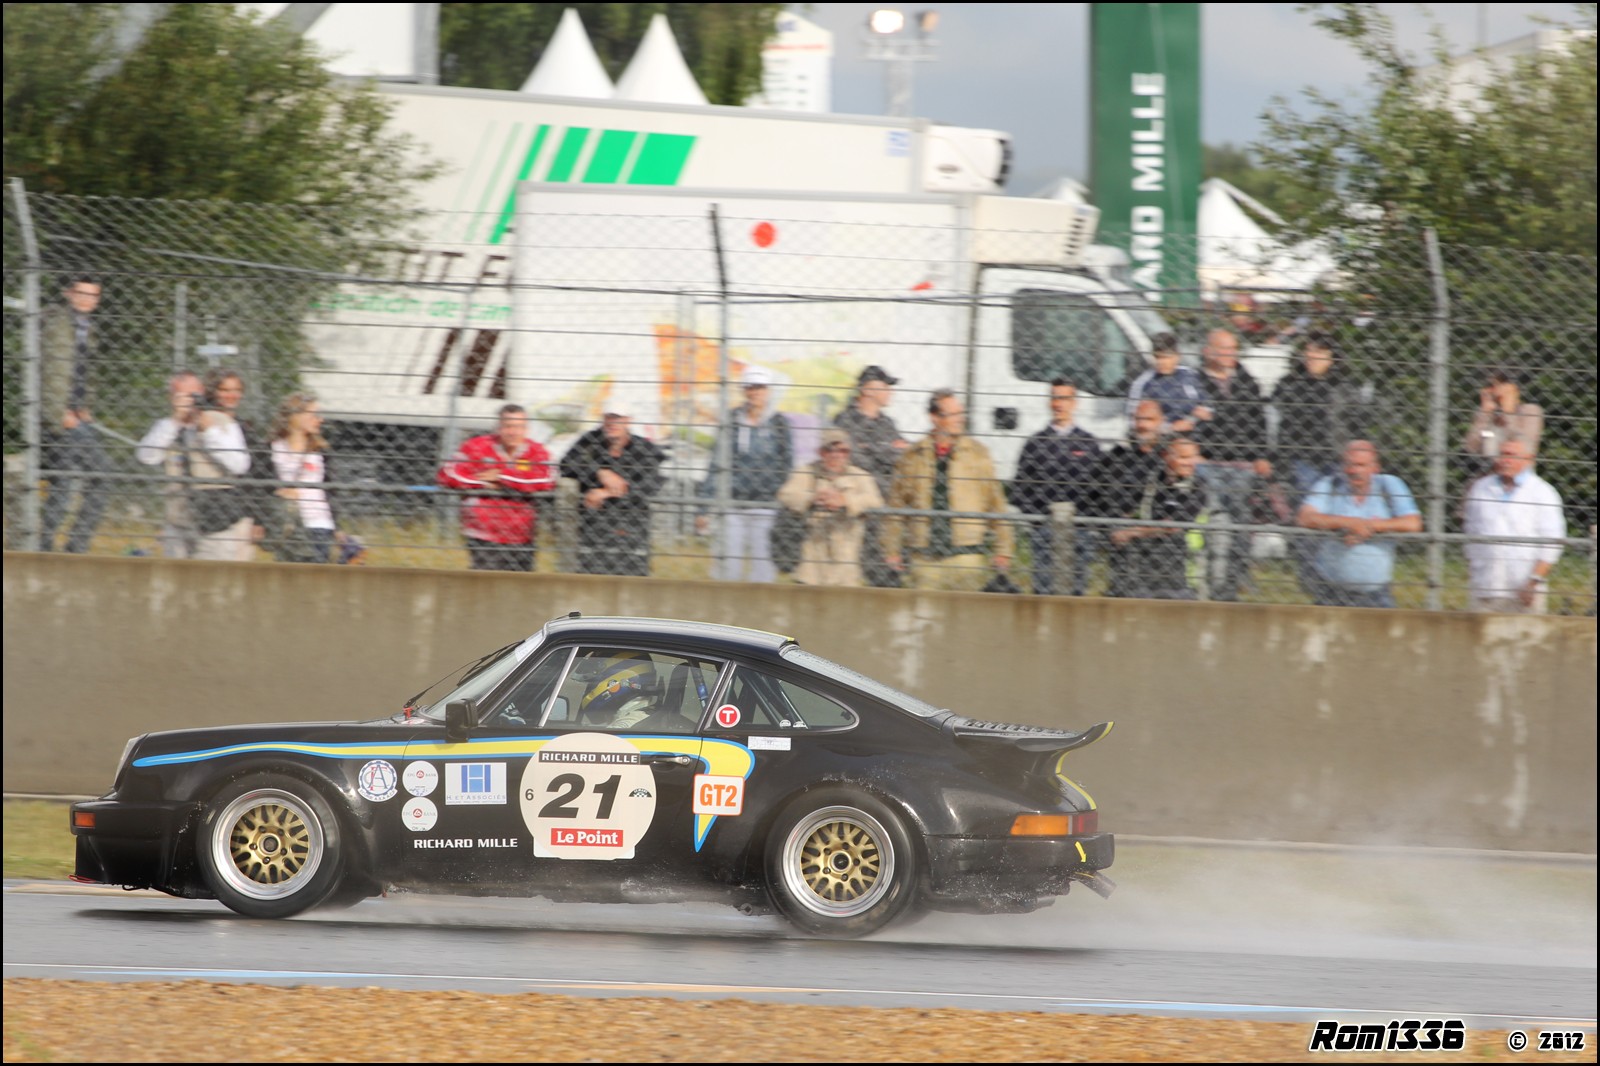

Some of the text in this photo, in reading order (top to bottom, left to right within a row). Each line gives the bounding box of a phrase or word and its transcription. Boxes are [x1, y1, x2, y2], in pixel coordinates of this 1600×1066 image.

[1131, 72, 1166, 191] MILLE
[541, 752, 639, 764] RICHARD MILLE
[525, 788, 535, 801] 6
[538, 772, 622, 820] 21
[699, 783, 738, 807] GT2
[413, 838, 519, 849] RICHARD MILLE
[556, 830, 619, 845] Le Point
